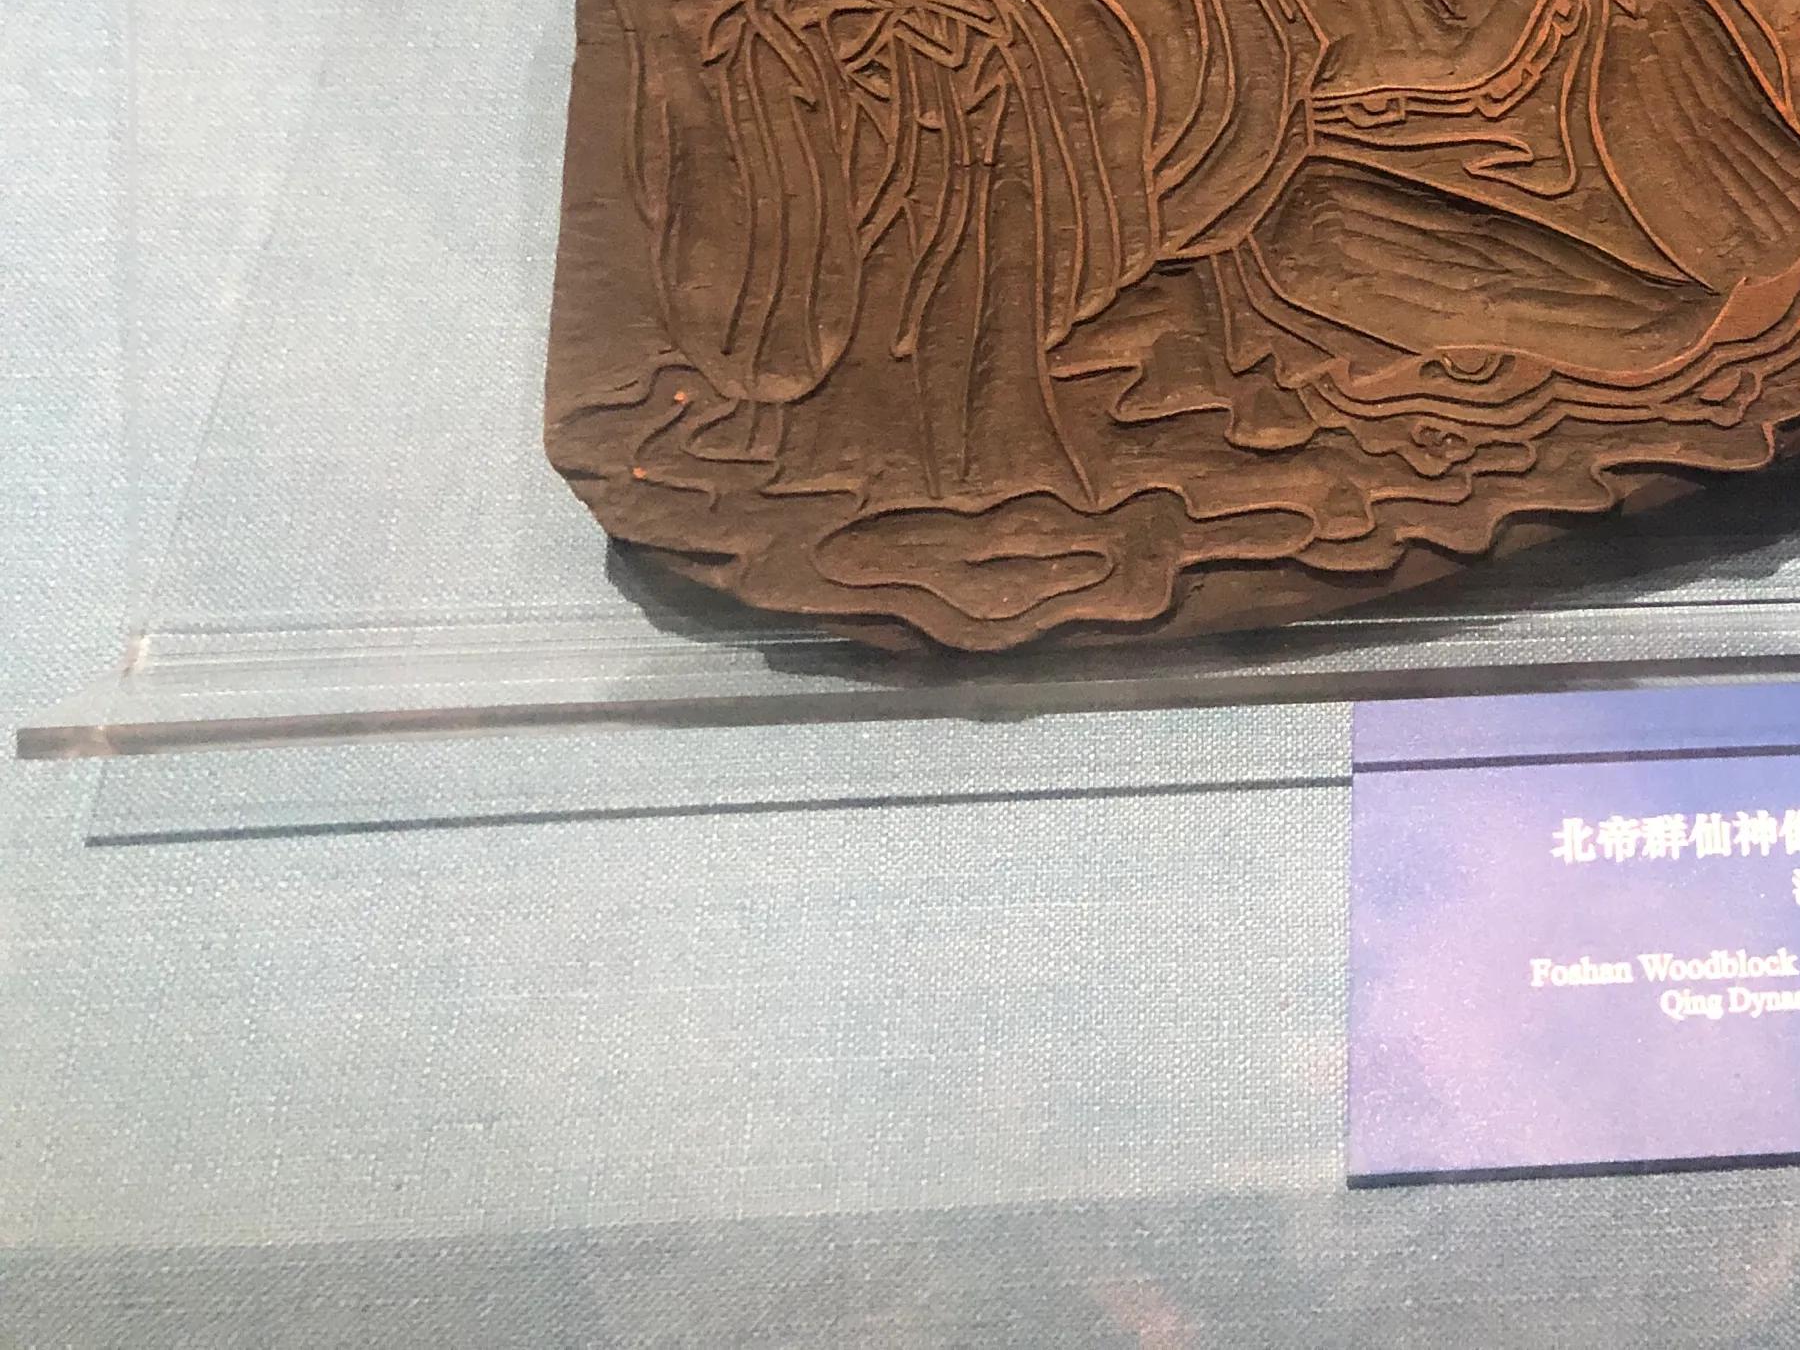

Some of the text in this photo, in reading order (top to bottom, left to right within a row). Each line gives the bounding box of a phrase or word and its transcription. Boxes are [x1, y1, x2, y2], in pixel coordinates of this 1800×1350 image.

[1532, 956, 1634, 986] Foshan
[1641, 948, 1799, 982] Woodblock
[1660, 990, 1725, 1021] Qing
